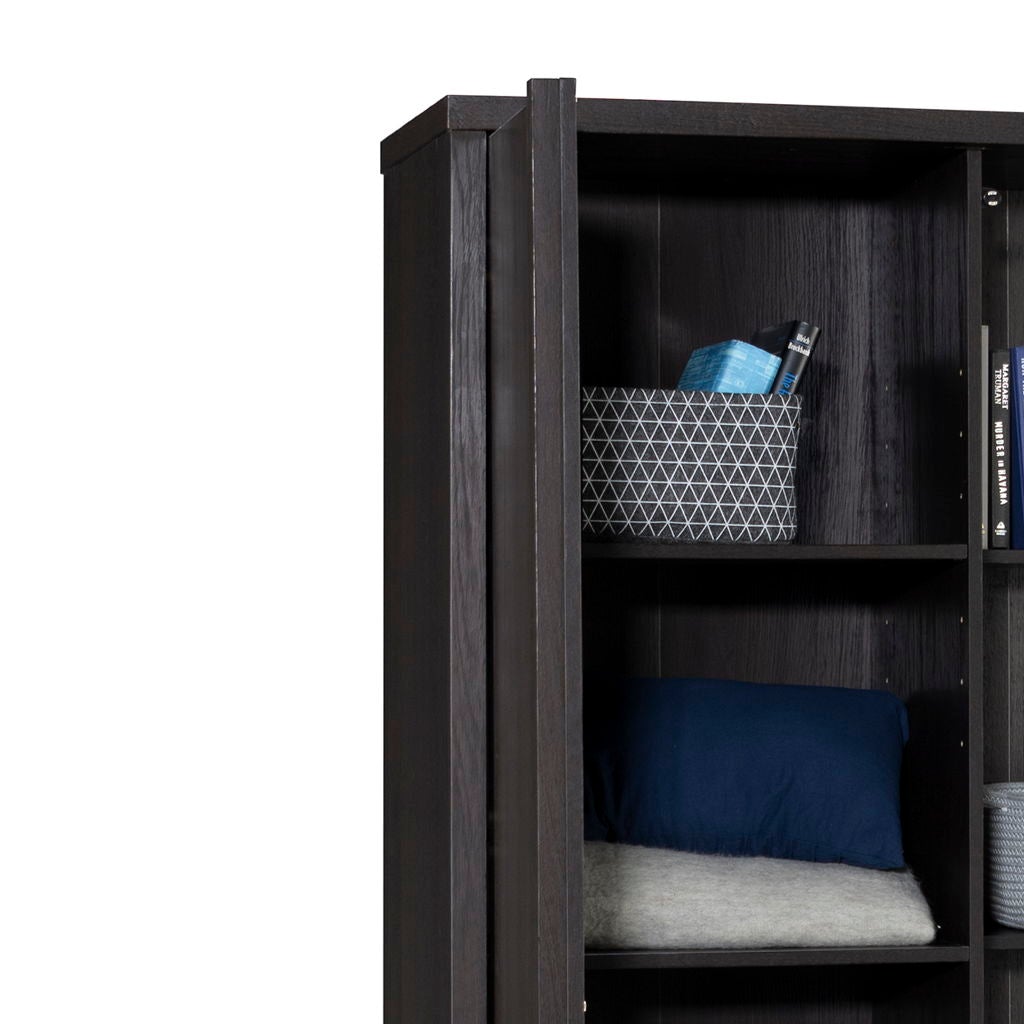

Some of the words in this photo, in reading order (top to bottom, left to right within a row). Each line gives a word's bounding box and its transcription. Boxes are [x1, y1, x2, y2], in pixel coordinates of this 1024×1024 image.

[994, 369, 1002, 405] TRUMAN
[1001, 363, 1009, 410] MARGARET
[994, 421, 1005, 457] MURDER
[997, 469, 1009, 506] HAVANA
